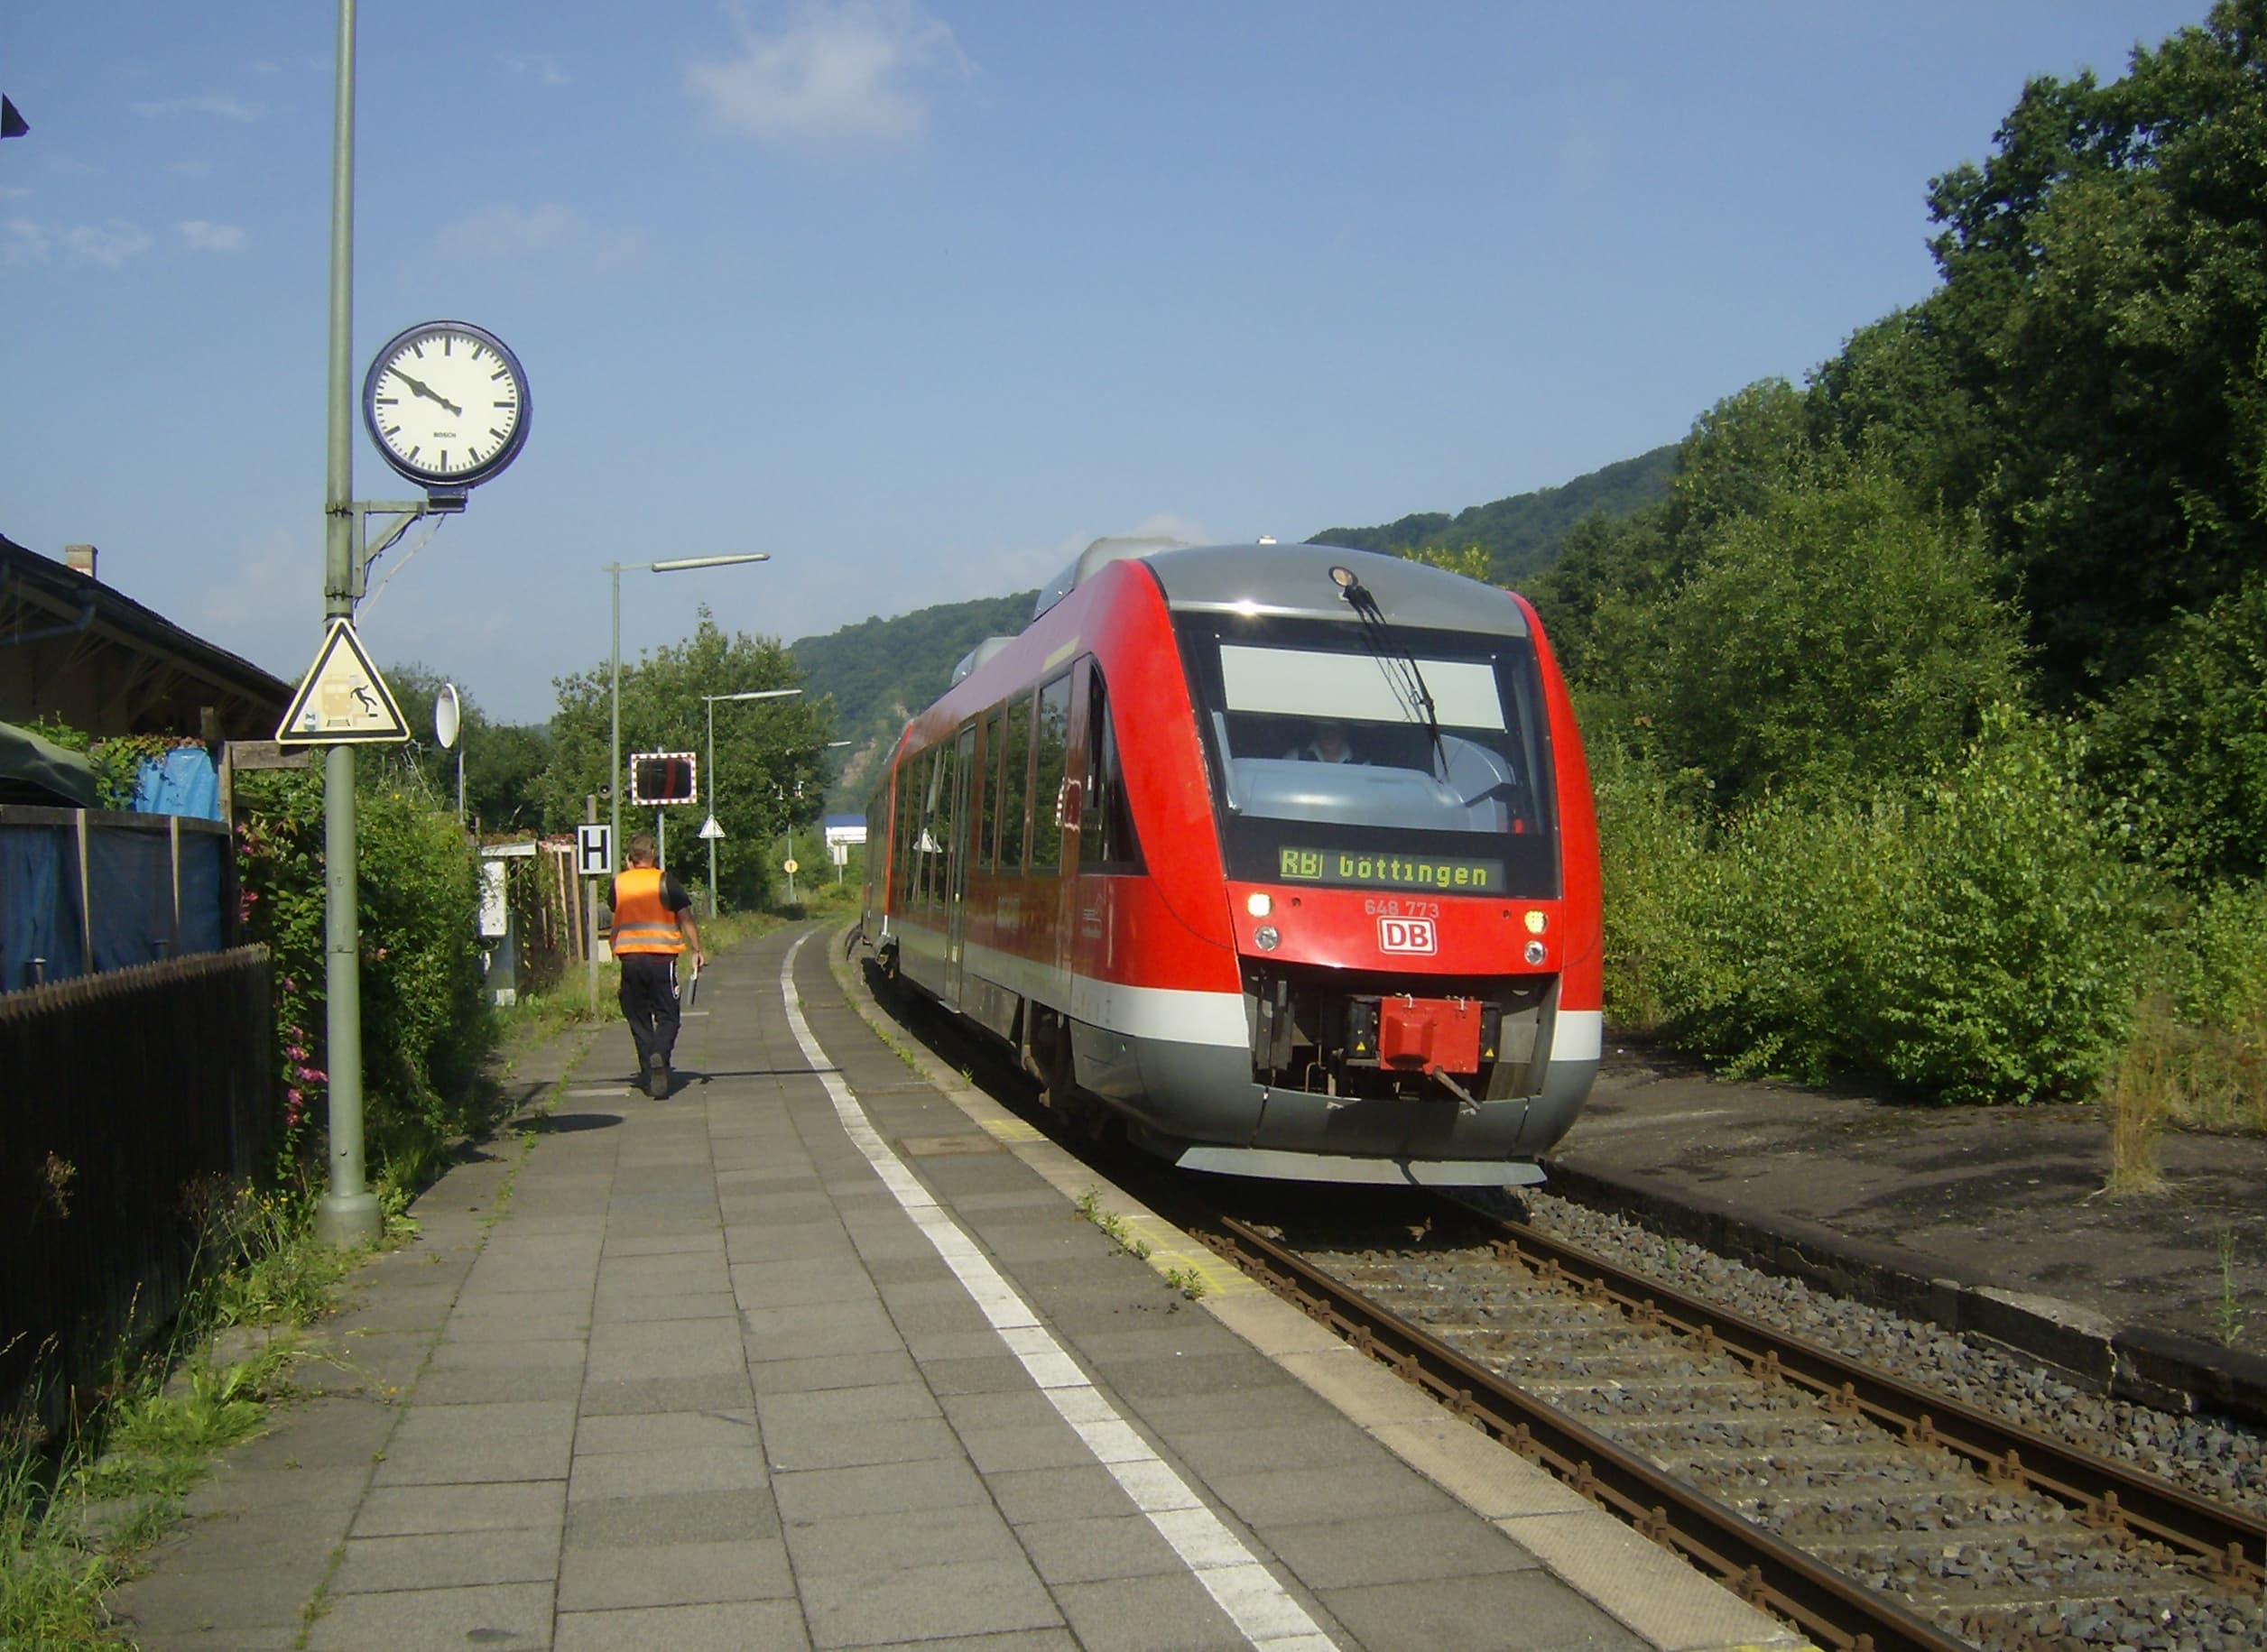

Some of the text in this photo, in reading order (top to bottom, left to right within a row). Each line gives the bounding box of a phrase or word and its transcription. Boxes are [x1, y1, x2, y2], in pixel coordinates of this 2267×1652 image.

[582, 829, 607, 870] H
[1282, 849, 1486, 887] RB Göttingen
[1365, 899, 1439, 918] 648 773
[1386, 922, 1429, 947] DB
